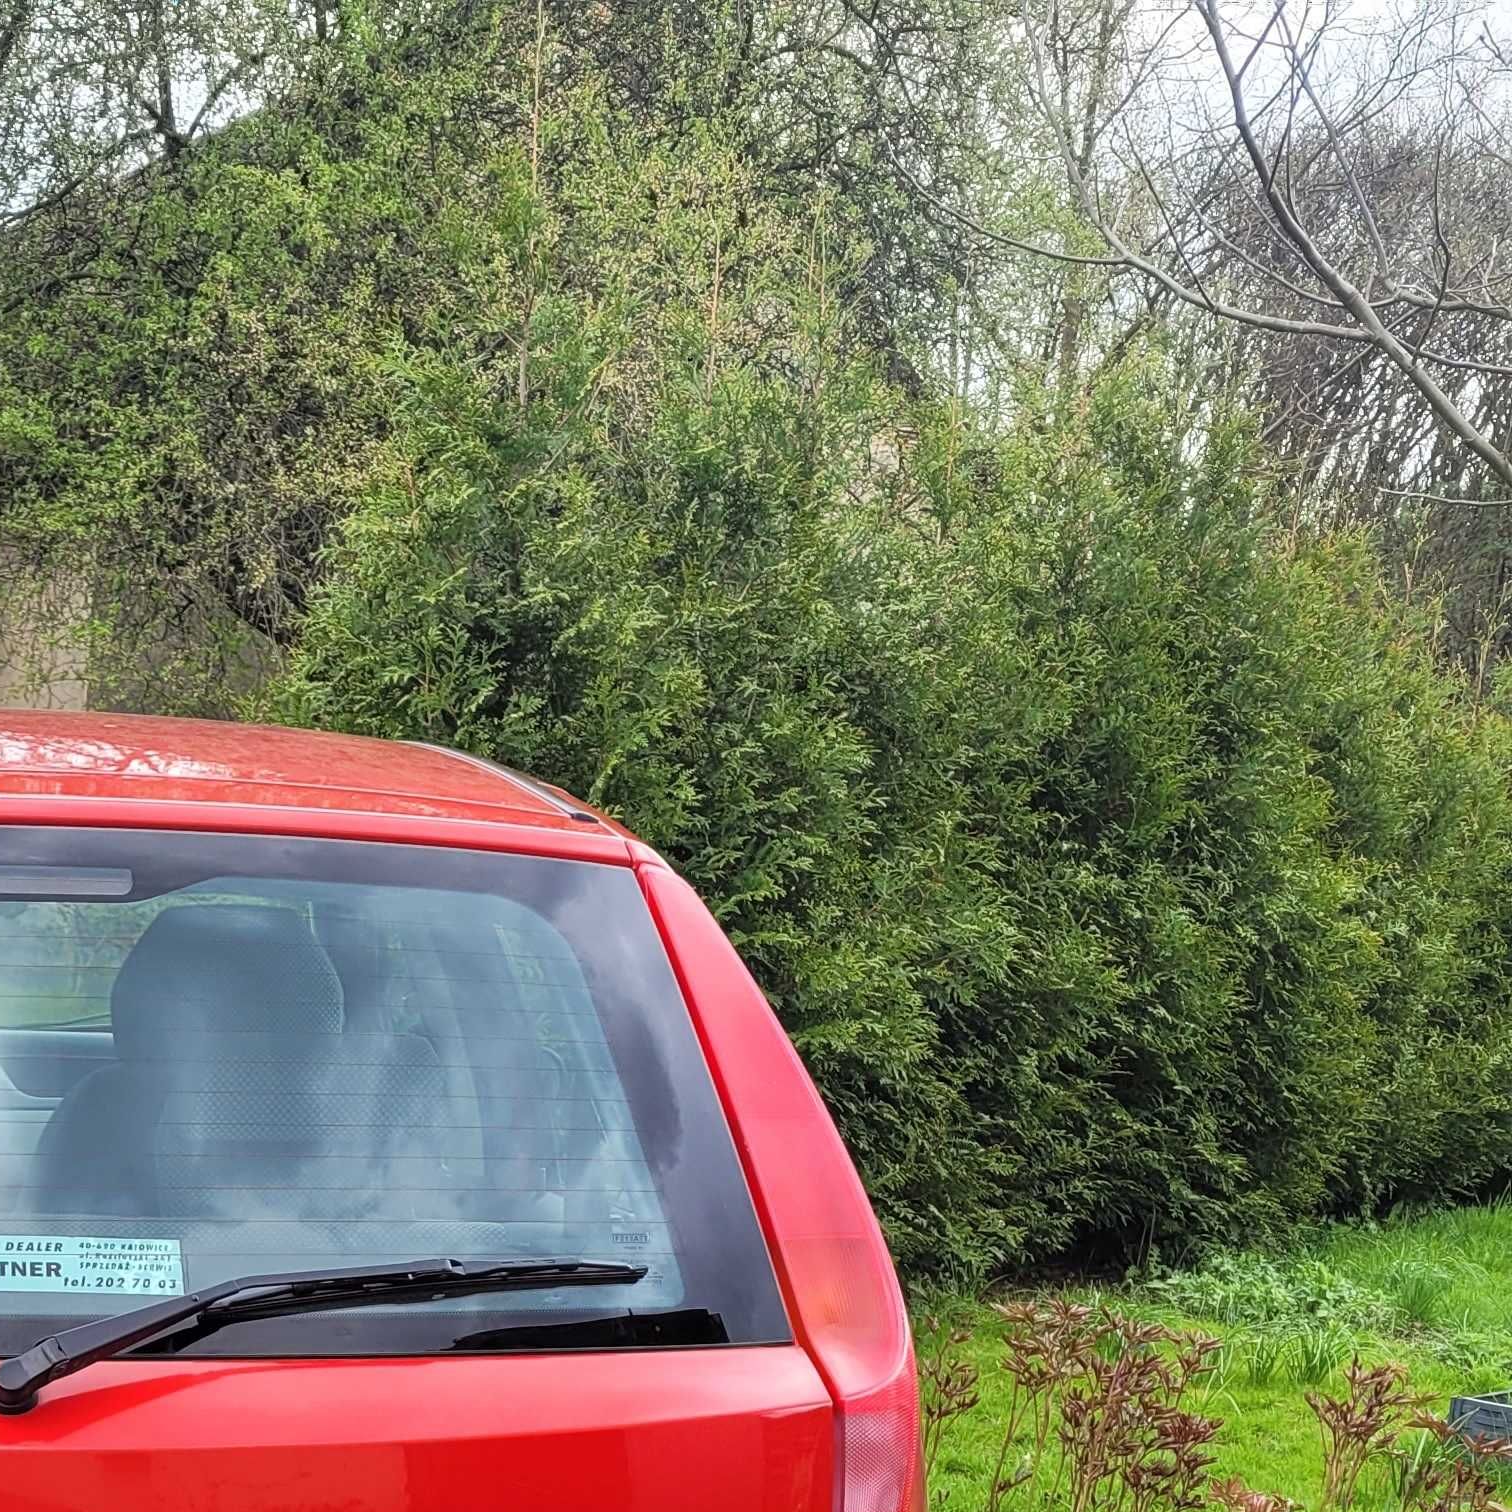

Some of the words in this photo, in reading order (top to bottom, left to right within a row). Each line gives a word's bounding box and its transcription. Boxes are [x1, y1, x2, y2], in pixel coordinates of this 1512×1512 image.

[5, 1241, 64, 1252] DEALER
[120, 1243, 169, 1252] KATOWICE
[63, 1276, 92, 1288] tel.
[96, 1277, 125, 1289] 202
[132, 1278, 151, 1289] 70
